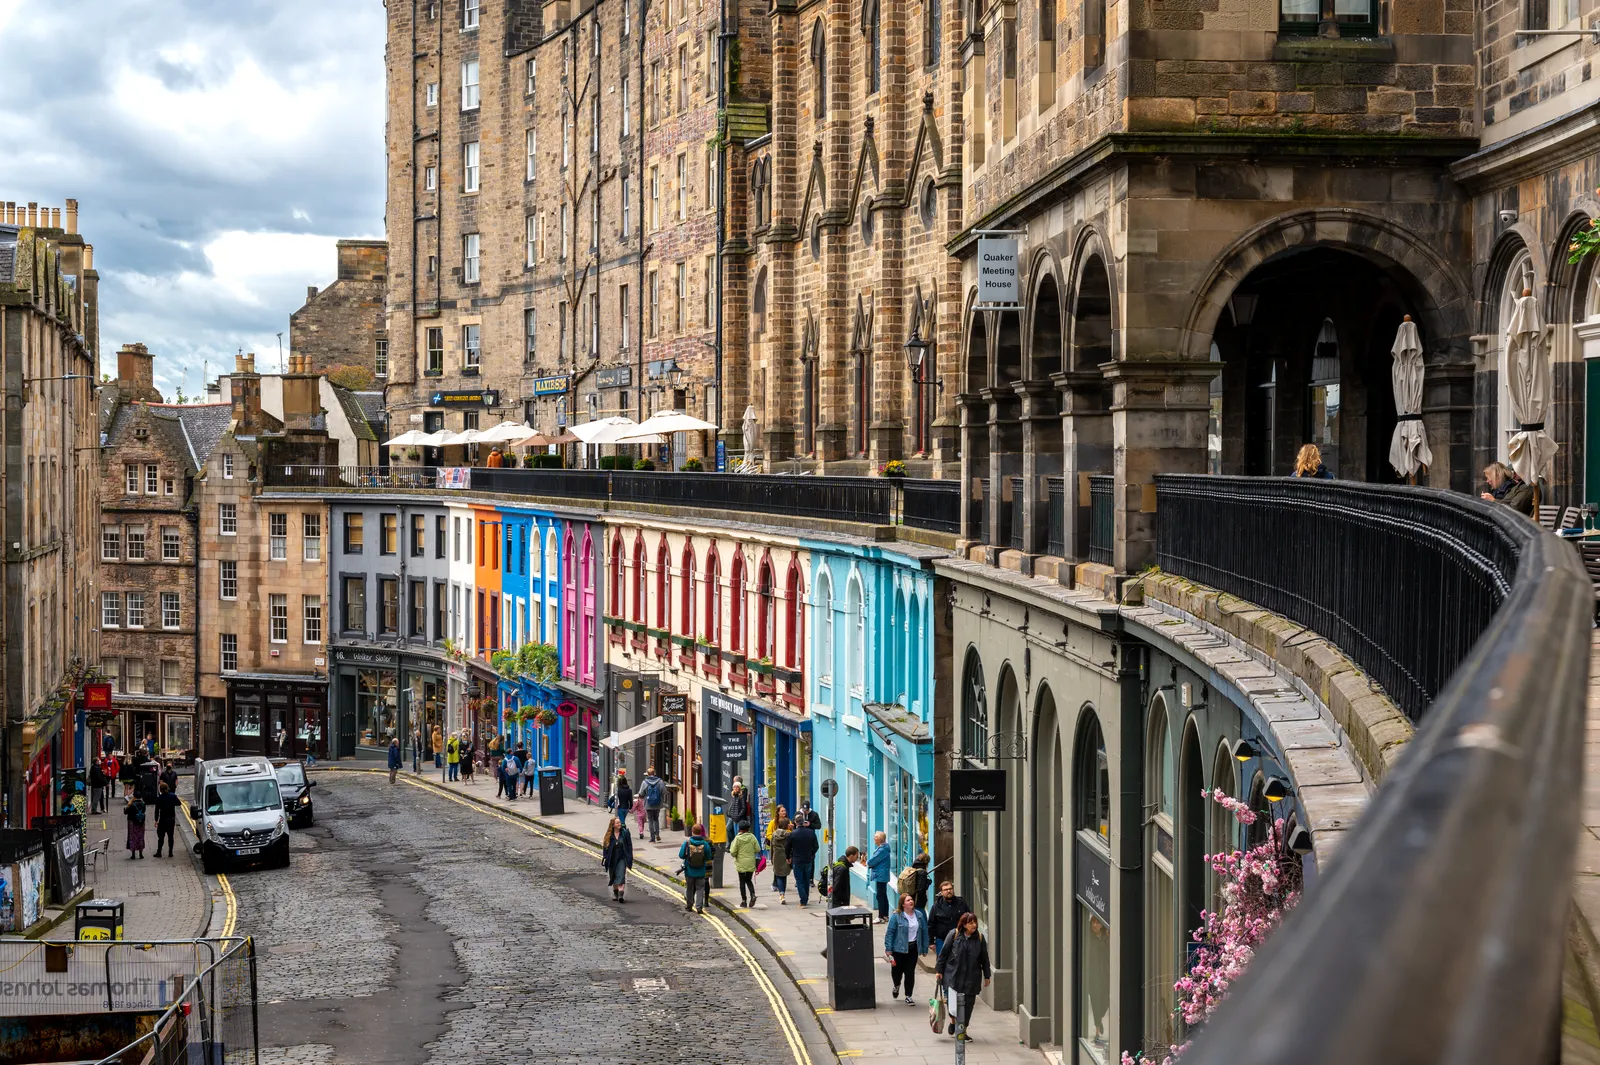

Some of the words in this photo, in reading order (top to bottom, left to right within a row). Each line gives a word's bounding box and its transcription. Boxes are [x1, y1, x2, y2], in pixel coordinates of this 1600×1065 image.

[983, 253, 1014, 261] Quaker
[982, 267, 1015, 276] Meeting
[985, 280, 1012, 288] House
[353, 653, 373, 661] Walker
[375, 654, 392, 663] Slater
[710, 695, 718, 707] THE
[718, 696, 733, 712] WHISKY
[733, 703, 744, 716] SHOP
